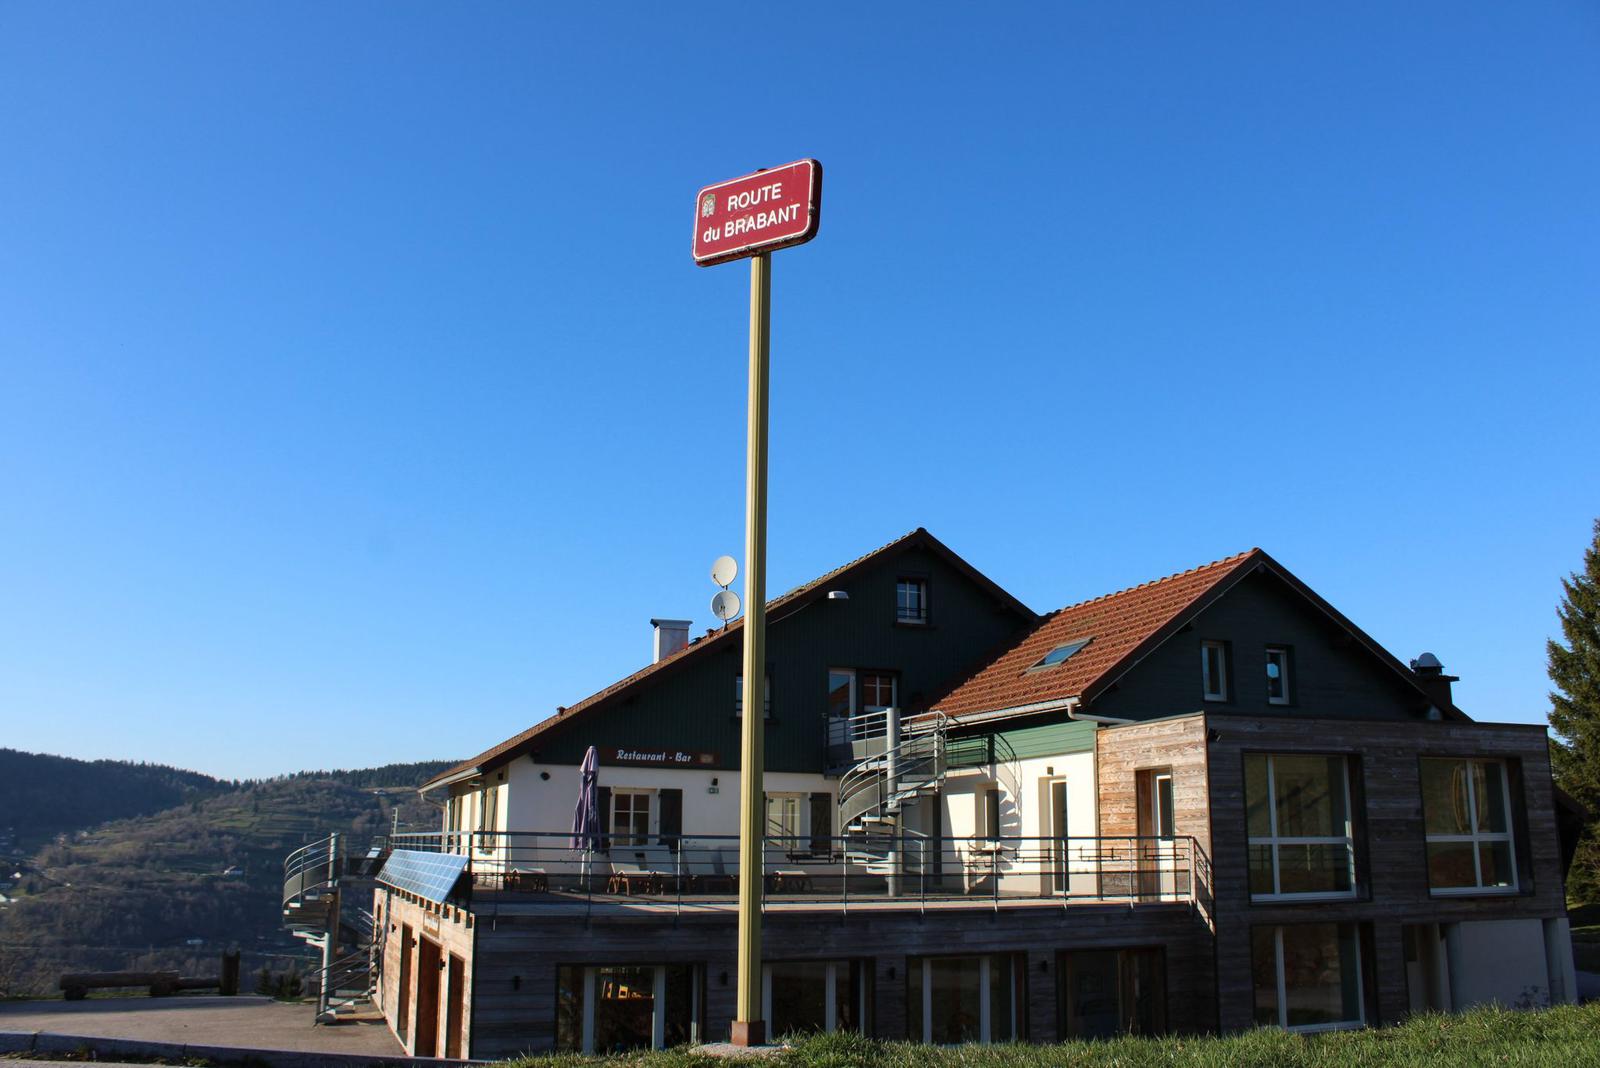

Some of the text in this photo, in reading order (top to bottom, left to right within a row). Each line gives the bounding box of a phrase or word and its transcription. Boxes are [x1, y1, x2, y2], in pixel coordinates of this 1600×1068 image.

[727, 182, 782, 212] ROUTE
[703, 203, 801, 243] du BRABANT
[616, 749, 666, 762] Restaurant
[675, 751, 691, 763] Bar
